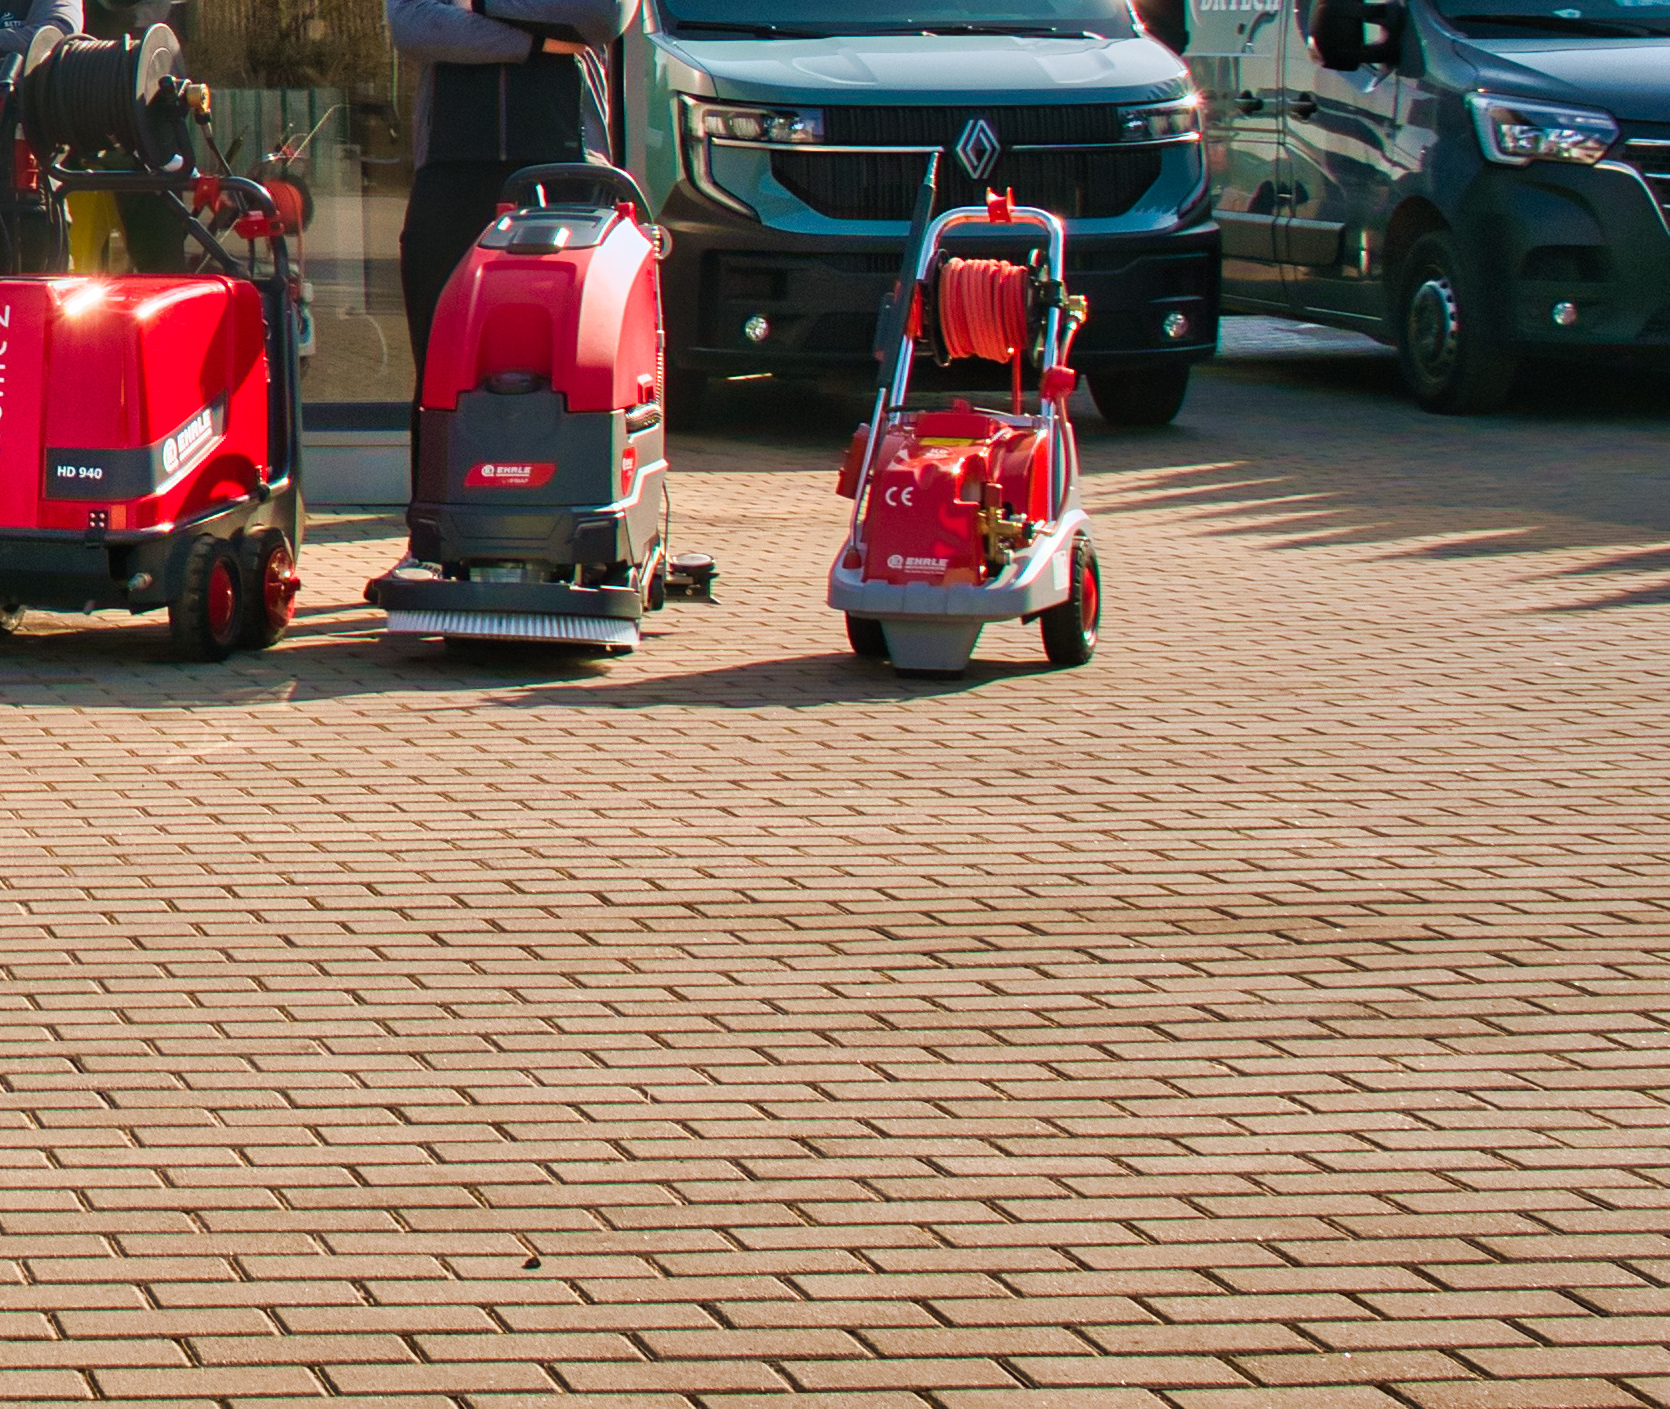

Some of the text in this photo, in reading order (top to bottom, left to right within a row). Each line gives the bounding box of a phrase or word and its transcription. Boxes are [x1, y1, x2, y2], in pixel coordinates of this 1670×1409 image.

[57, 465, 103, 480] HD 940
[905, 556, 949, 567] EHRLE
